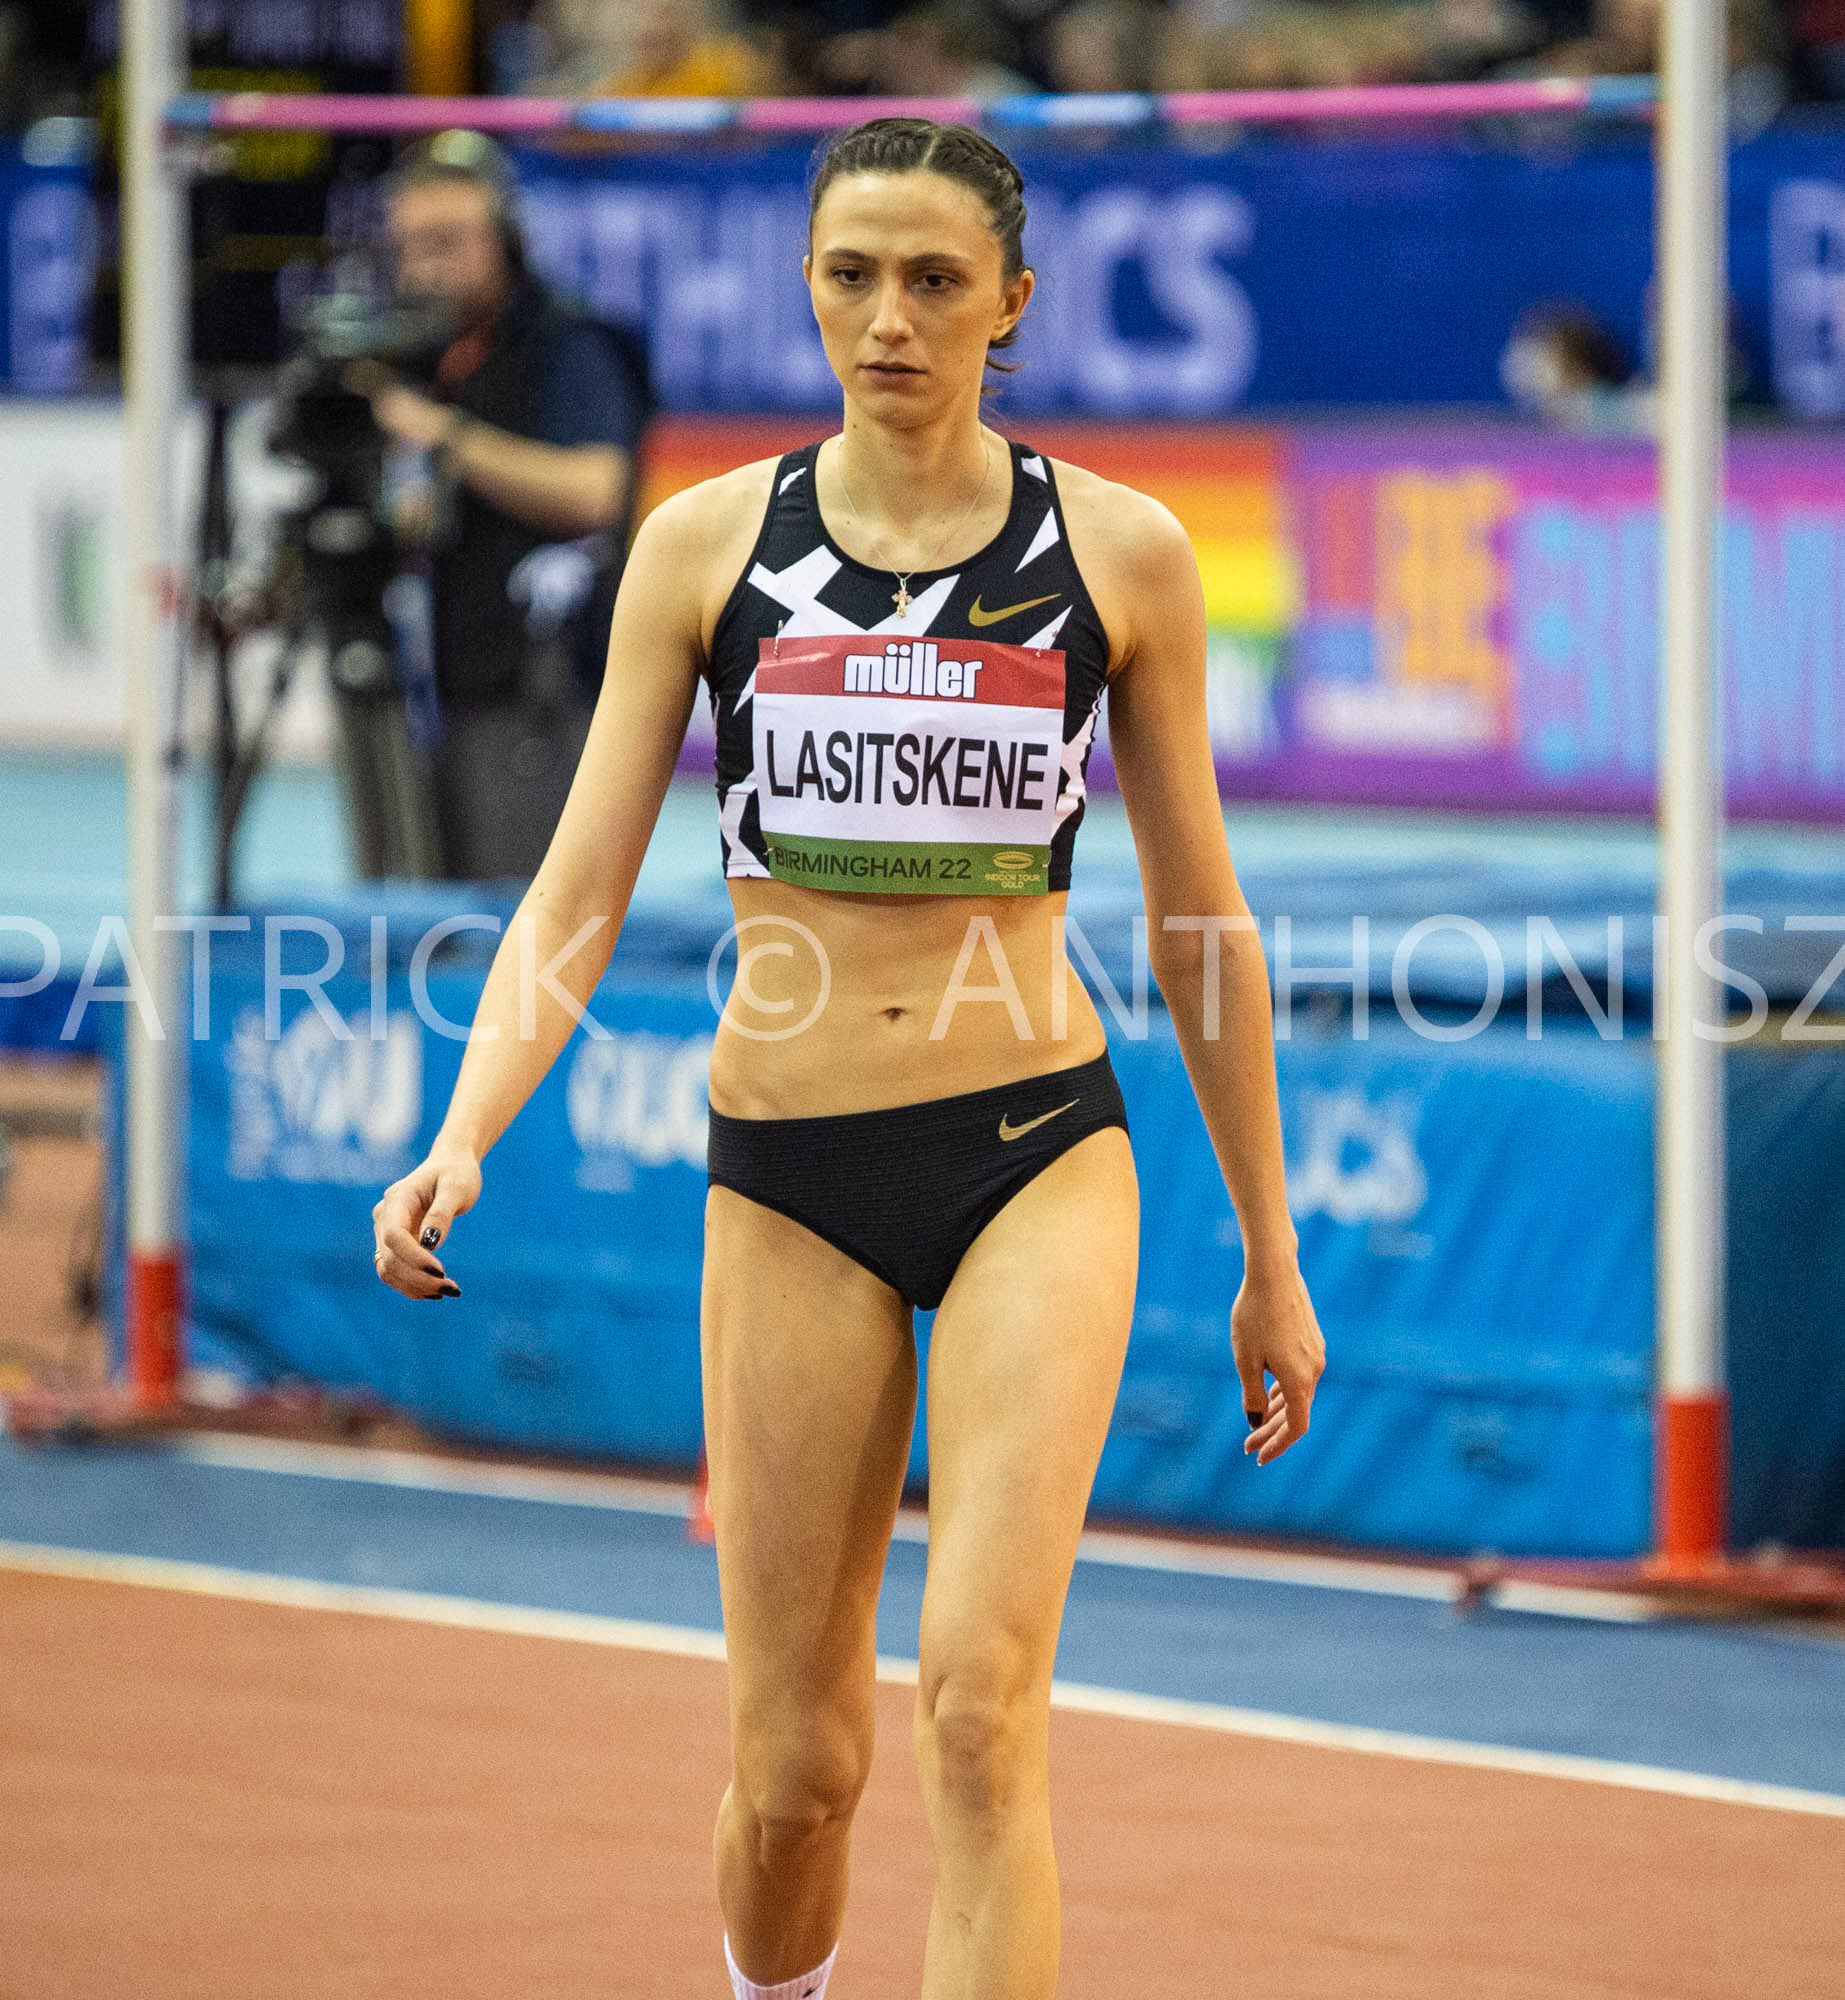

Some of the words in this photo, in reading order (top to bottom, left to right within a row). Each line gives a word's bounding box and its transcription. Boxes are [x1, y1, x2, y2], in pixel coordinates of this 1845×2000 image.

[843, 641, 983, 700] müller
[766, 729, 1049, 811] LASITSKENE
[774, 848, 931, 879] BIRMINGHAM
[938, 858, 972, 880] 22
[1018, 873, 1041, 882] TOUR
[1001, 880, 1024, 889] GOLD
